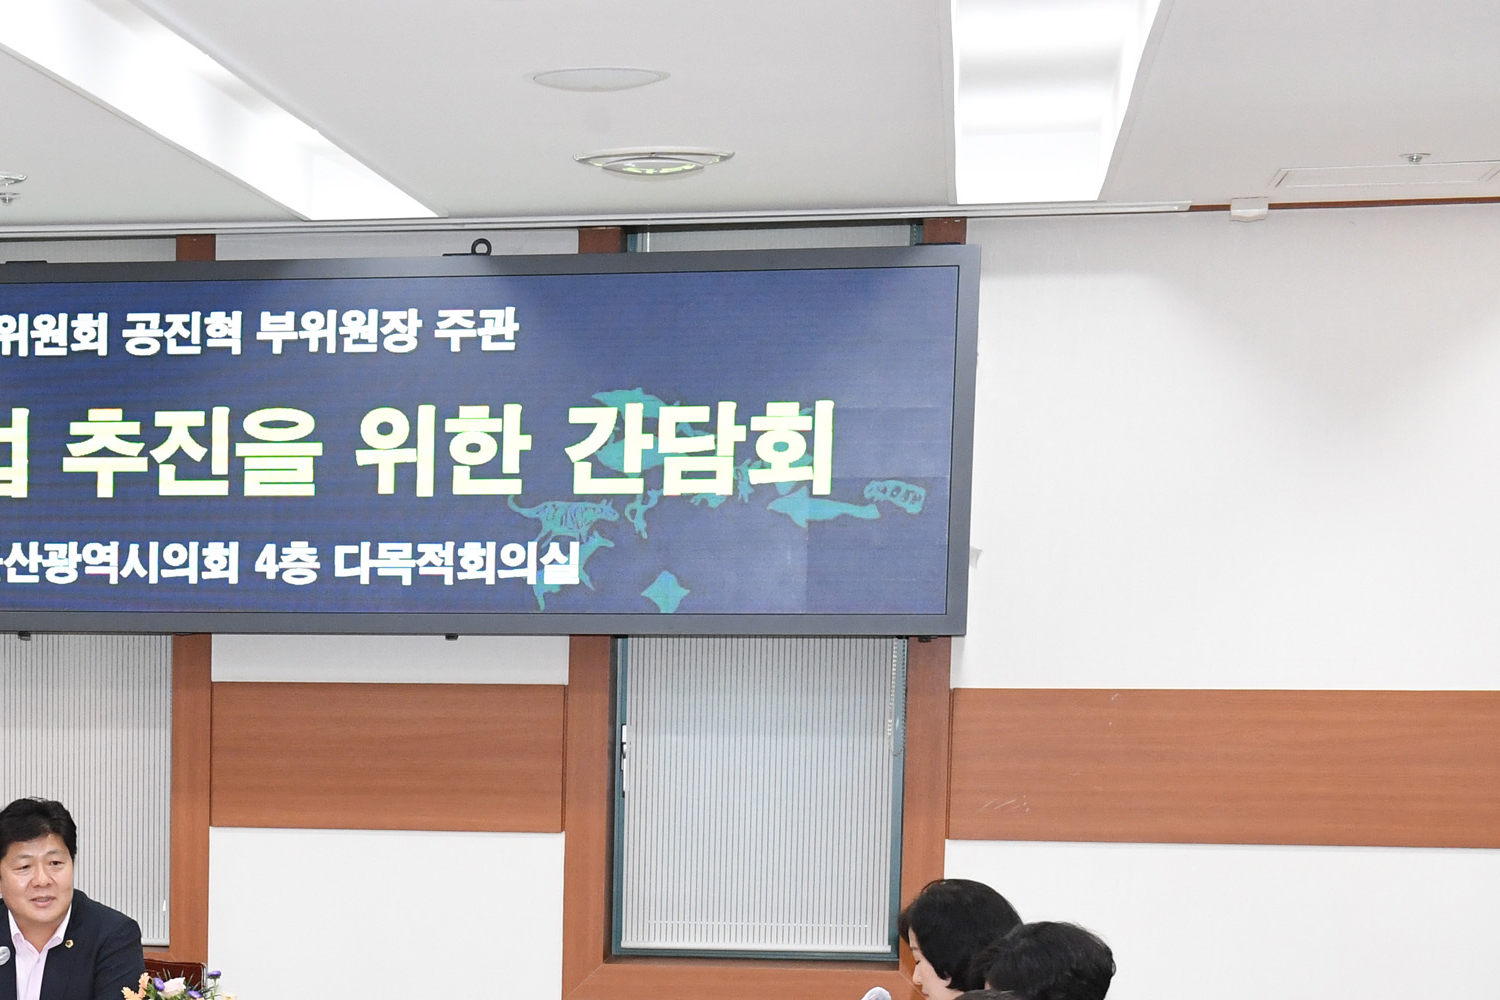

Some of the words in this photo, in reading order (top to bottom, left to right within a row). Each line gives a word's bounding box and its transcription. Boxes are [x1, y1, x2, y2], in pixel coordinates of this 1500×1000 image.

[122, 310, 243, 356] 공진혁
[256, 308, 423, 355] 부위원장
[434, 306, 520, 353] 주관
[62, 406, 323, 498] 추진을
[354, 403, 533, 498] 위한
[564, 399, 835, 497] 간담회
[254, 541, 321, 586] 4층
[334, 541, 580, 586] 다목적회의실
